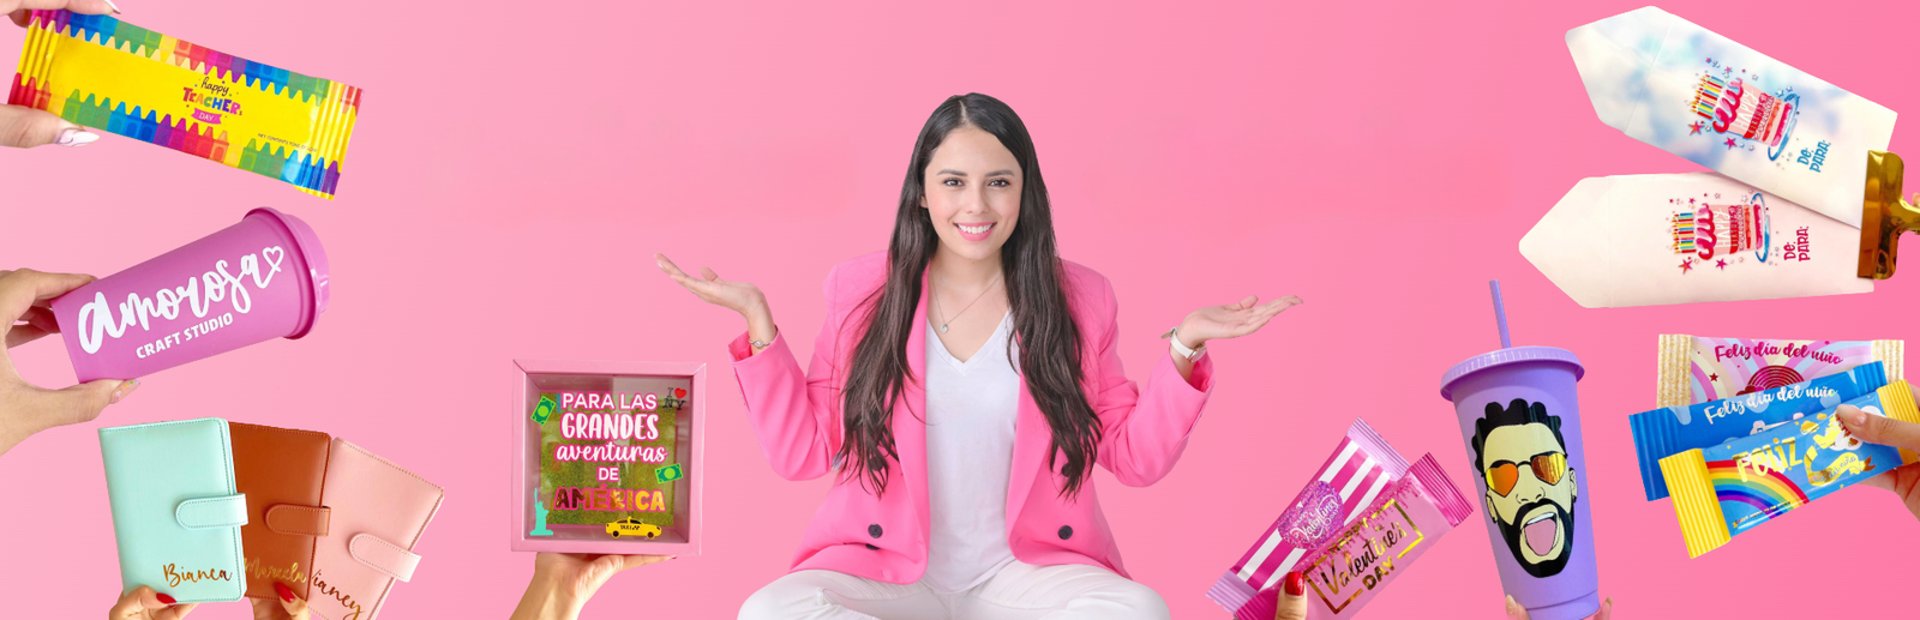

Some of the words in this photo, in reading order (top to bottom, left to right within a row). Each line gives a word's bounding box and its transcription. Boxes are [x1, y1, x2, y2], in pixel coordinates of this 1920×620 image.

[201, 76, 229, 97] happy
[136, 332, 181, 359] CRAFT
[185, 312, 234, 341] STUDIO
[1714, 344, 1751, 362] Feliz
[1753, 341, 1781, 356] día
[1783, 342, 1809, 358] del
[1811, 349, 1843, 365] niño
[562, 393, 615, 409] PARA
[620, 393, 657, 410] LAS
[1703, 401, 1746, 425] Feliz
[1746, 391, 1774, 408] día
[1776, 384, 1803, 402] del
[1805, 385, 1837, 398] niño
[561, 412, 659, 440] GRANDES
[556, 441, 667, 463] aventuras
[598, 467, 619, 481] DE
[554, 484, 666, 511] AMÉRICA
[1320, 521, 1407, 595] Valentine's
[163, 562, 233, 588] Bianca
[1362, 555, 1395, 591] DAY
